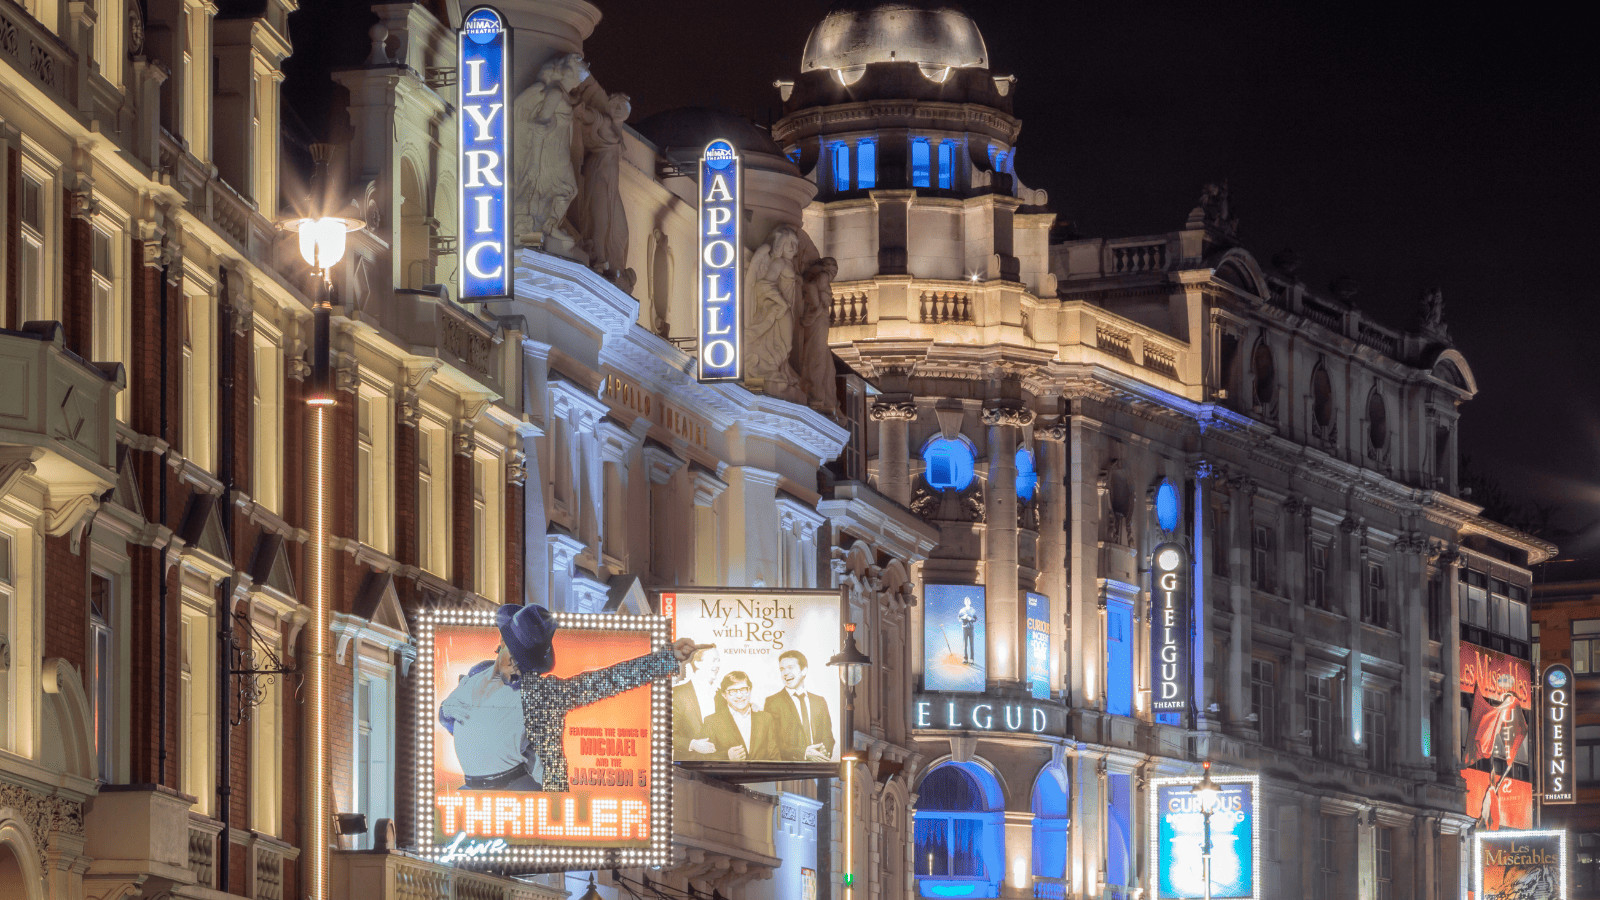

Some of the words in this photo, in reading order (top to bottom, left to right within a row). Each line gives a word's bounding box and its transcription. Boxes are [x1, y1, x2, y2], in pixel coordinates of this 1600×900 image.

[467, 18, 499, 29] NIMAX
[463, 60, 503, 279] LYRIC
[703, 174, 735, 368] APOLLO
[606, 375, 650, 417] APOLLO
[699, 599, 732, 627] My
[735, 599, 795, 629] Night
[712, 624, 743, 638] with
[745, 622, 785, 650] Reg
[1161, 573, 1178, 699] GIELGUD
[1154, 701, 1185, 709] THEATRE
[569, 727, 603, 737] FEATURING
[604, 728, 616, 737] THE
[1550, 689, 1569, 792] QUEENS
[580, 737, 637, 757] MICHAEL
[595, 757, 609, 768] AND
[610, 758, 622, 768] THE
[570, 767, 634, 786] JACKSON
[638, 769, 647, 787] 5
[1168, 796, 1242, 813] CUROUS
[437, 796, 647, 838] THRILLER
[440, 831, 508, 863] Live
[1485, 848, 1561, 866] Misérables
[1510, 841, 1530, 854] Les
